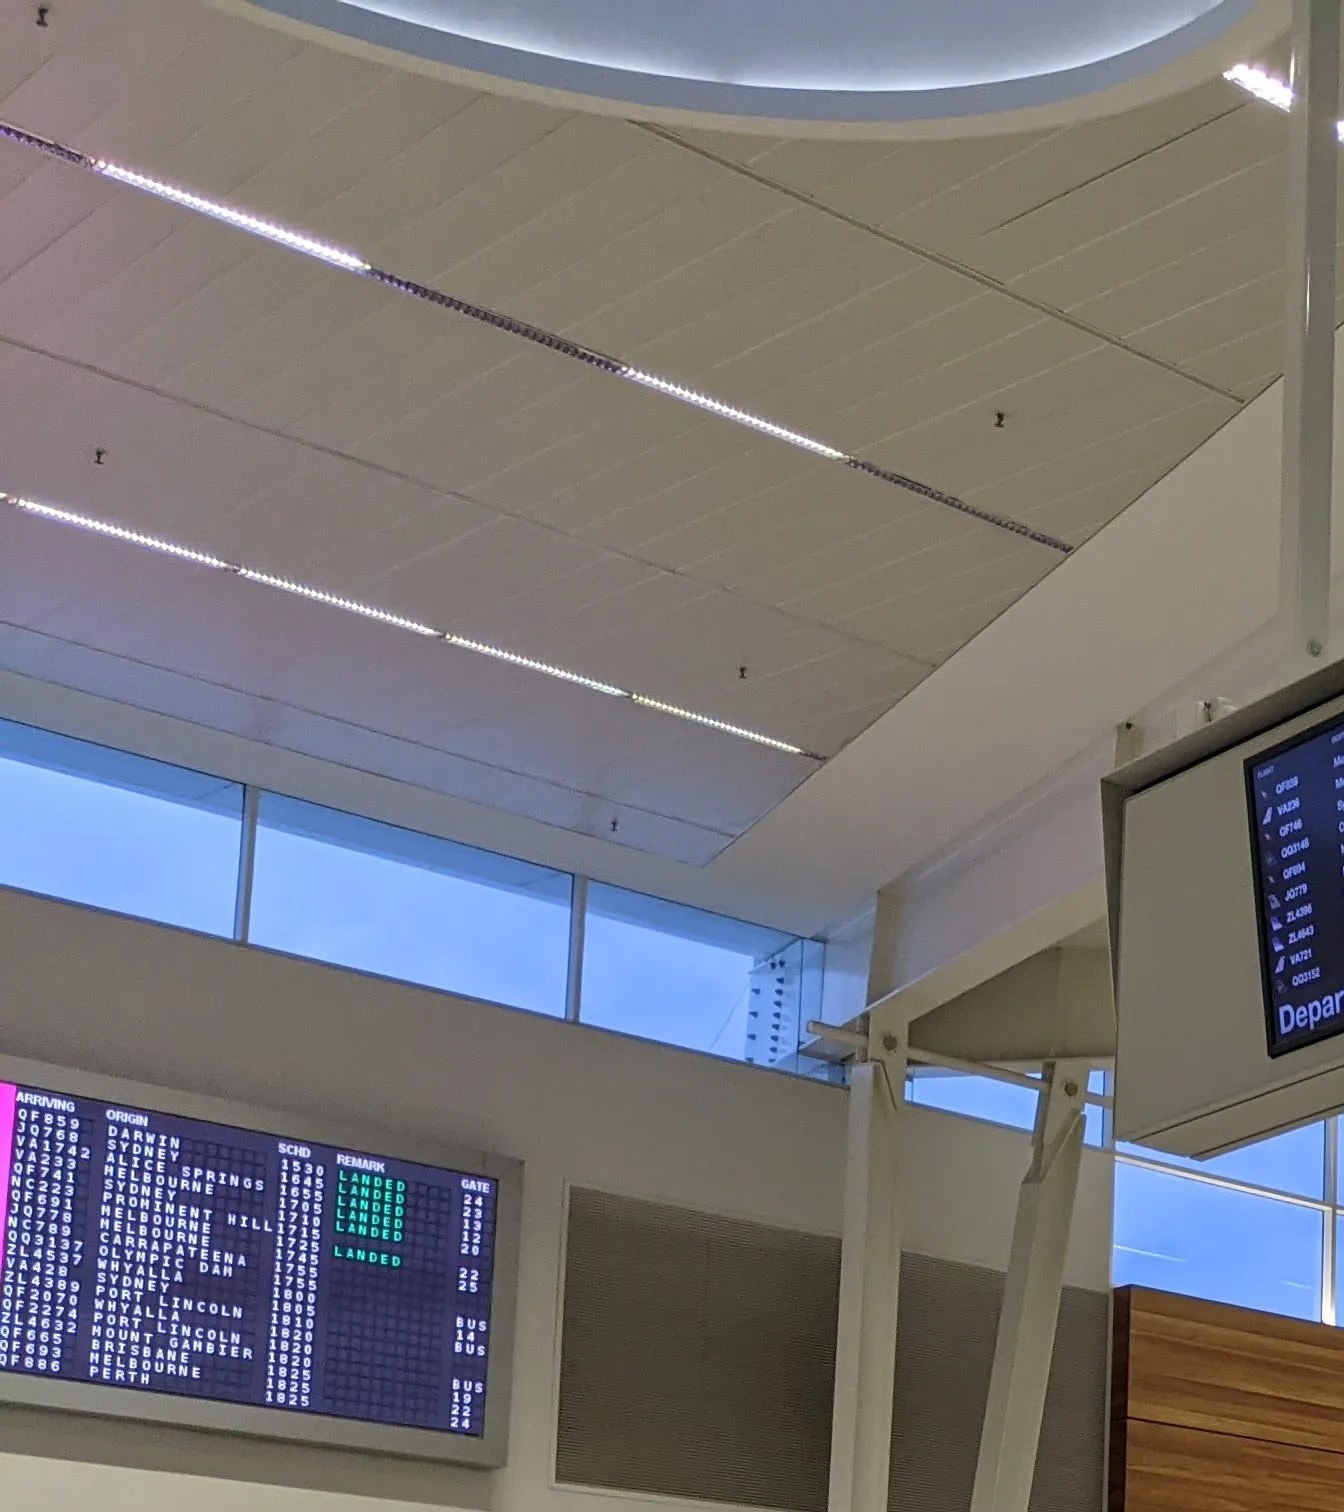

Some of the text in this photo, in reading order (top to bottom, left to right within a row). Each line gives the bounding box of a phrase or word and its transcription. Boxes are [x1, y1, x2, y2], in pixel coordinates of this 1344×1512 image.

[16, 1091, 491, 1194] ARRIVING ORIGIN SCHD REMARK GATE
[16, 1136, 481, 1232] VA1742 ALICE SPRINGS 1655 LANDED 13
[17, 1122, 482, 1220] JQ768 SYDNEY 1645 LANDED 23
[18, 1109, 482, 1208] QF859 DARWIN 1530 LANDED 24
[12, 1190, 478, 1282] QF691 MELBOURNE 1725 LANDED 22
[13, 1177, 320, 1240] NC223 PROMINENT HILL 1715
[14, 1163, 480, 1257] QF741 SYDNEY 1710 LANDED 20
[15, 1150, 480, 1245] VA233 MELBOURNE 1705 LANDED 12
[7, 1245, 487, 1332] ZL4537 WHYALLA 1800 BUS
[8, 1231, 317, 1292] QQ3137 OLYMPIC DAM 1755
[9, 1218, 318, 1279] NC789 CARRAPATEENA 1755
[10, 1204, 478, 1294] JQ778 MELBOURNE 1745 25
[3, 1299, 313, 1356] QF2274 PORT LINCOLN 1820
[4, 1286, 314, 1343] QF2070 WHYALLA 1820
[5, 1272, 485, 1357] ZL4389 PORT LINCOLN 1810 BUS
[6, 1259, 475, 1343] VA428 SYDNEY 1805 14
[0, 1327, 471, 1405] QF665 BRISBANE 1825 19
[0, 1340, 471, 1417] QF693 MELBOURNE 1825 22
[0, 1354, 470, 1429] QF886 PERTH 1825 24
[1, 1313, 483, 1394] ZL4632 MOUNT GAMBIER 1820 BUS
